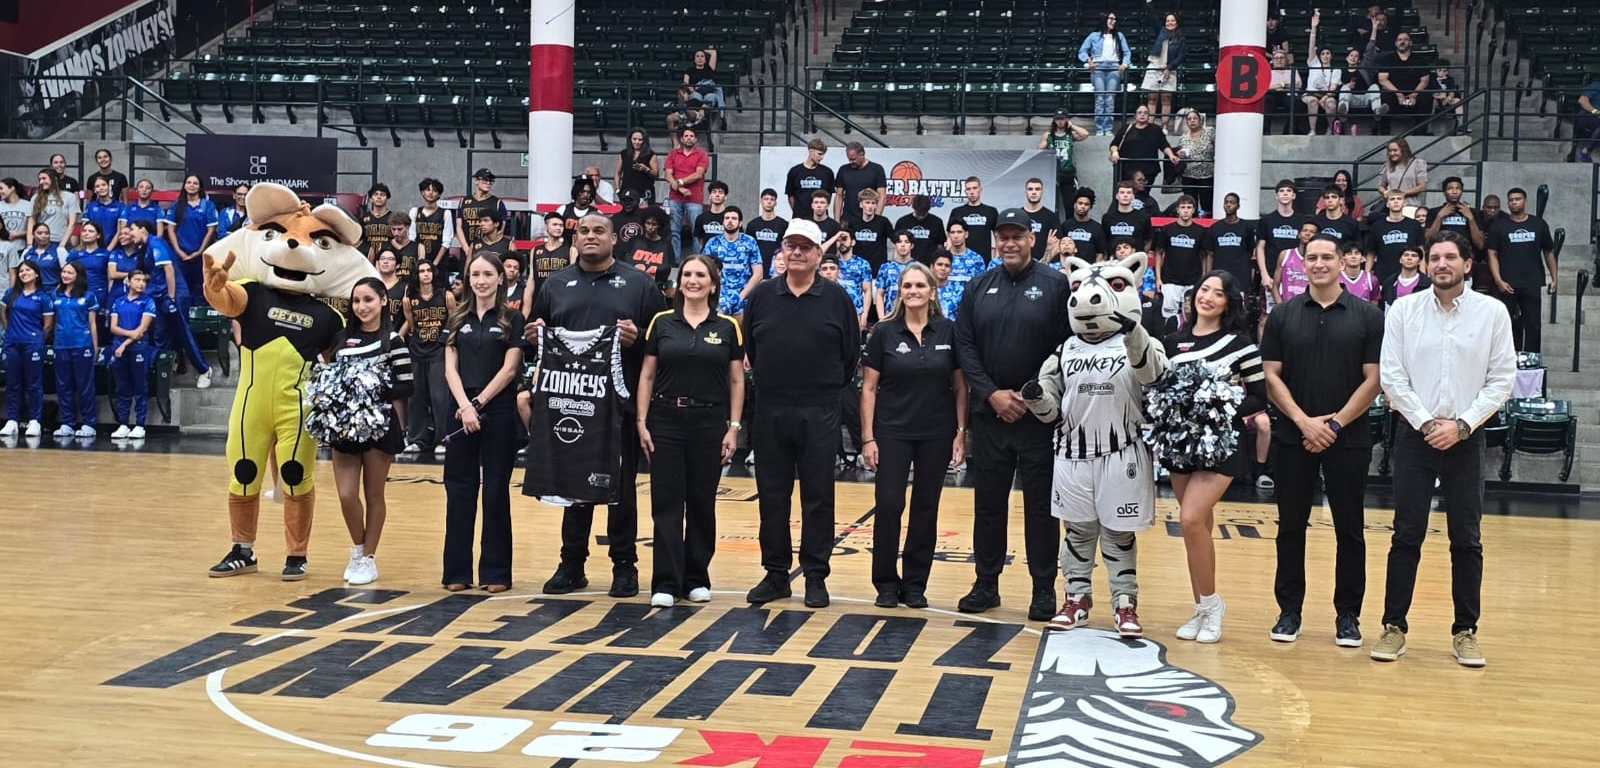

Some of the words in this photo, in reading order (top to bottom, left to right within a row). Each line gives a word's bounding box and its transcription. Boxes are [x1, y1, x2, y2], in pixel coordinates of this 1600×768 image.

[104, 7, 175, 70] ZONKEYS!
[1231, 56, 1258, 98] B
[210, 176, 224, 186] The
[268, 307, 314, 328] CETYS
[1066, 354, 1127, 380] ZONKEYS
[540, 368, 608, 399] ZONKEYS
[562, 399, 594, 411] Florido
[553, 425, 585, 434] NISSAN
[1116, 502, 1139, 515] abc
[231, 587, 1025, 671] ZONKEYS
[101, 632, 994, 741] TIJUANA
